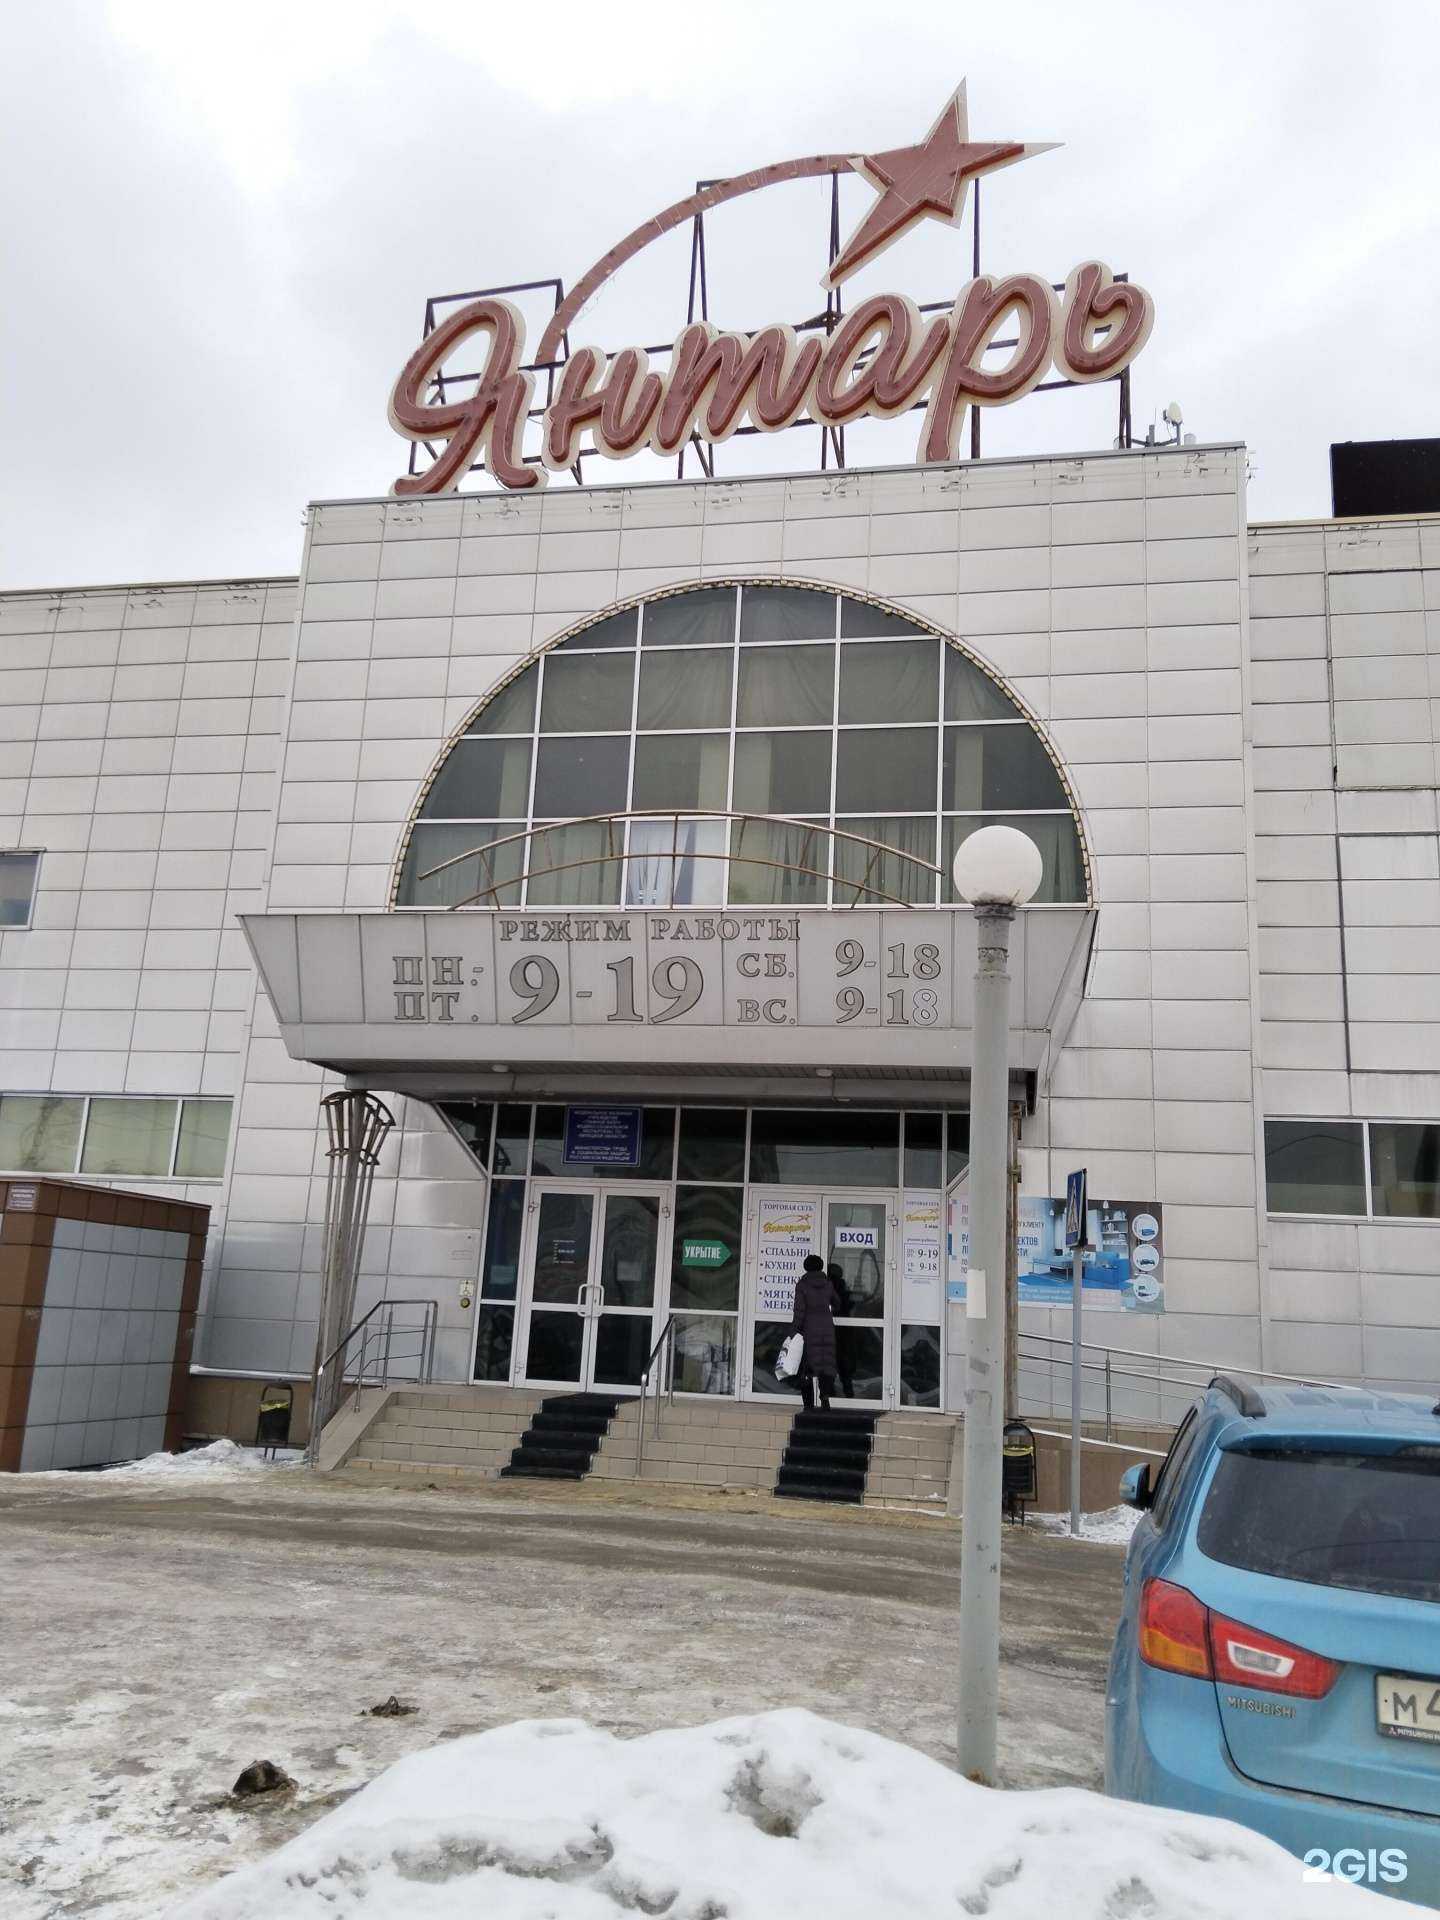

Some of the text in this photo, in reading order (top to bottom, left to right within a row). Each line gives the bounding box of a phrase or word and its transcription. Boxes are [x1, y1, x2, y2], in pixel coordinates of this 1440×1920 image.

[388, 260, 1154, 495] Янтарь
[499, 918, 800, 942] РЕЖИМ РАБОТЫ
[736, 939, 942, 980] СБ. 9-18
[509, 954, 704, 1024] 9-19
[736, 986, 939, 1026] ВС. 9-18
[839, 1231, 874, 1245] ВХОД
[684, 1245, 721, 1259] УКРЫТИЕ
[765, 1247, 810, 1258] СПАЛЬНИ
[918, 1248, 939, 1259] 9-19
[764, 1260, 797, 1270] КУХНИ
[919, 1262, 937, 1271] 9-18
[764, 1274, 801, 1285] СТЕНК
[763, 1289, 794, 1300] МЯГК
[763, 1300, 794, 1310] МЕБЕ
[1227, 1696, 1297, 1719] MITSUBISHI
